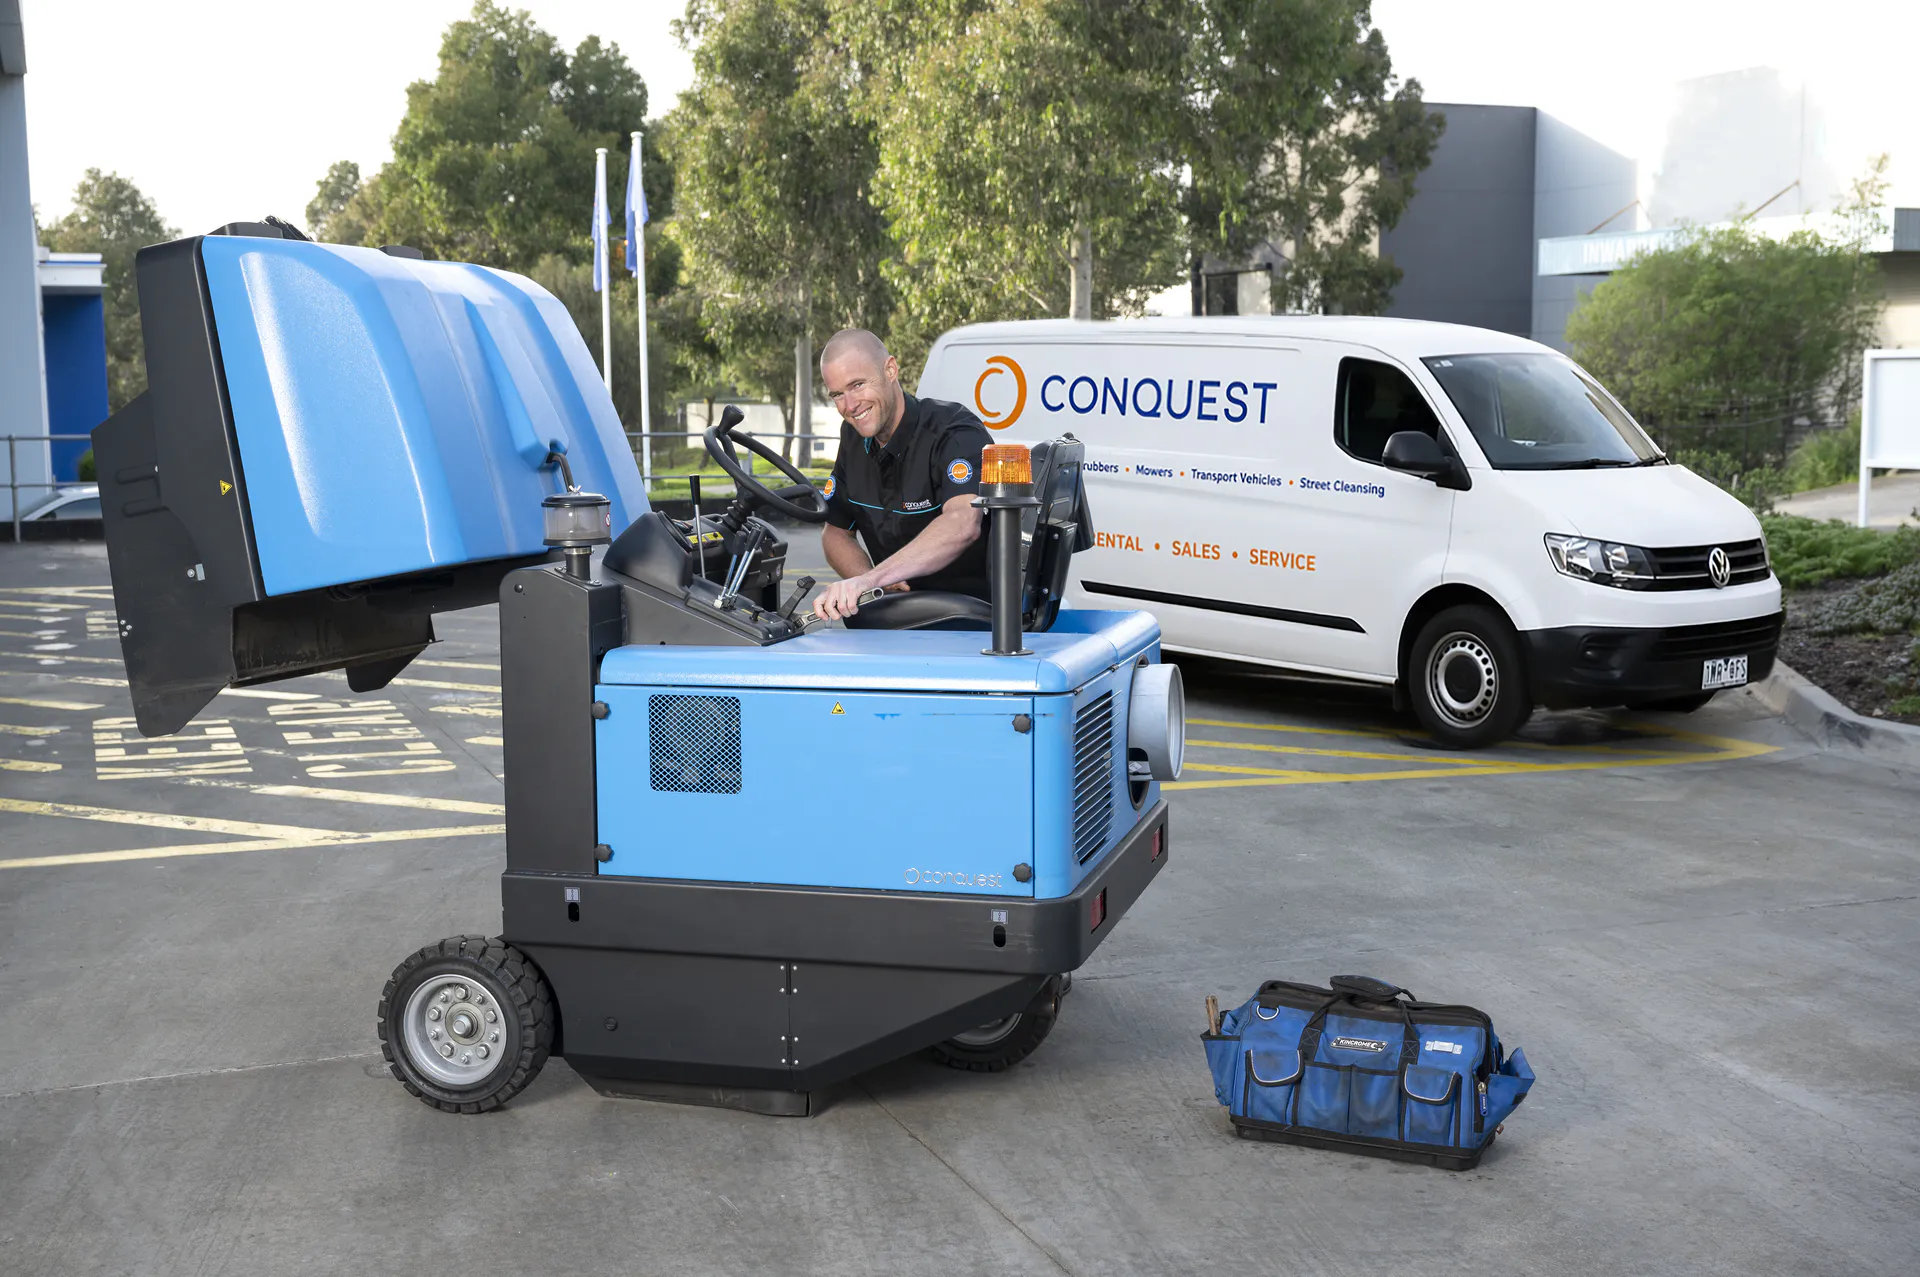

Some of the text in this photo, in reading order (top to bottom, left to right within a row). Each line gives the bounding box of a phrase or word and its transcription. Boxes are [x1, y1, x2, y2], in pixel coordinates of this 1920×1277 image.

[1040, 374, 1278, 424] CONQUEST
[1083, 461, 1385, 498] rubbers Mowers Transport Vehicles Street Cleansing
[1093, 531, 1316, 571] ENTAL SALES SERVICE
[92, 716, 254, 780] KEEP
[266, 700, 457, 778] CLEAR
[922, 870, 1002, 888] conquest
[1339, 1039, 1372, 1048] KINCROME
